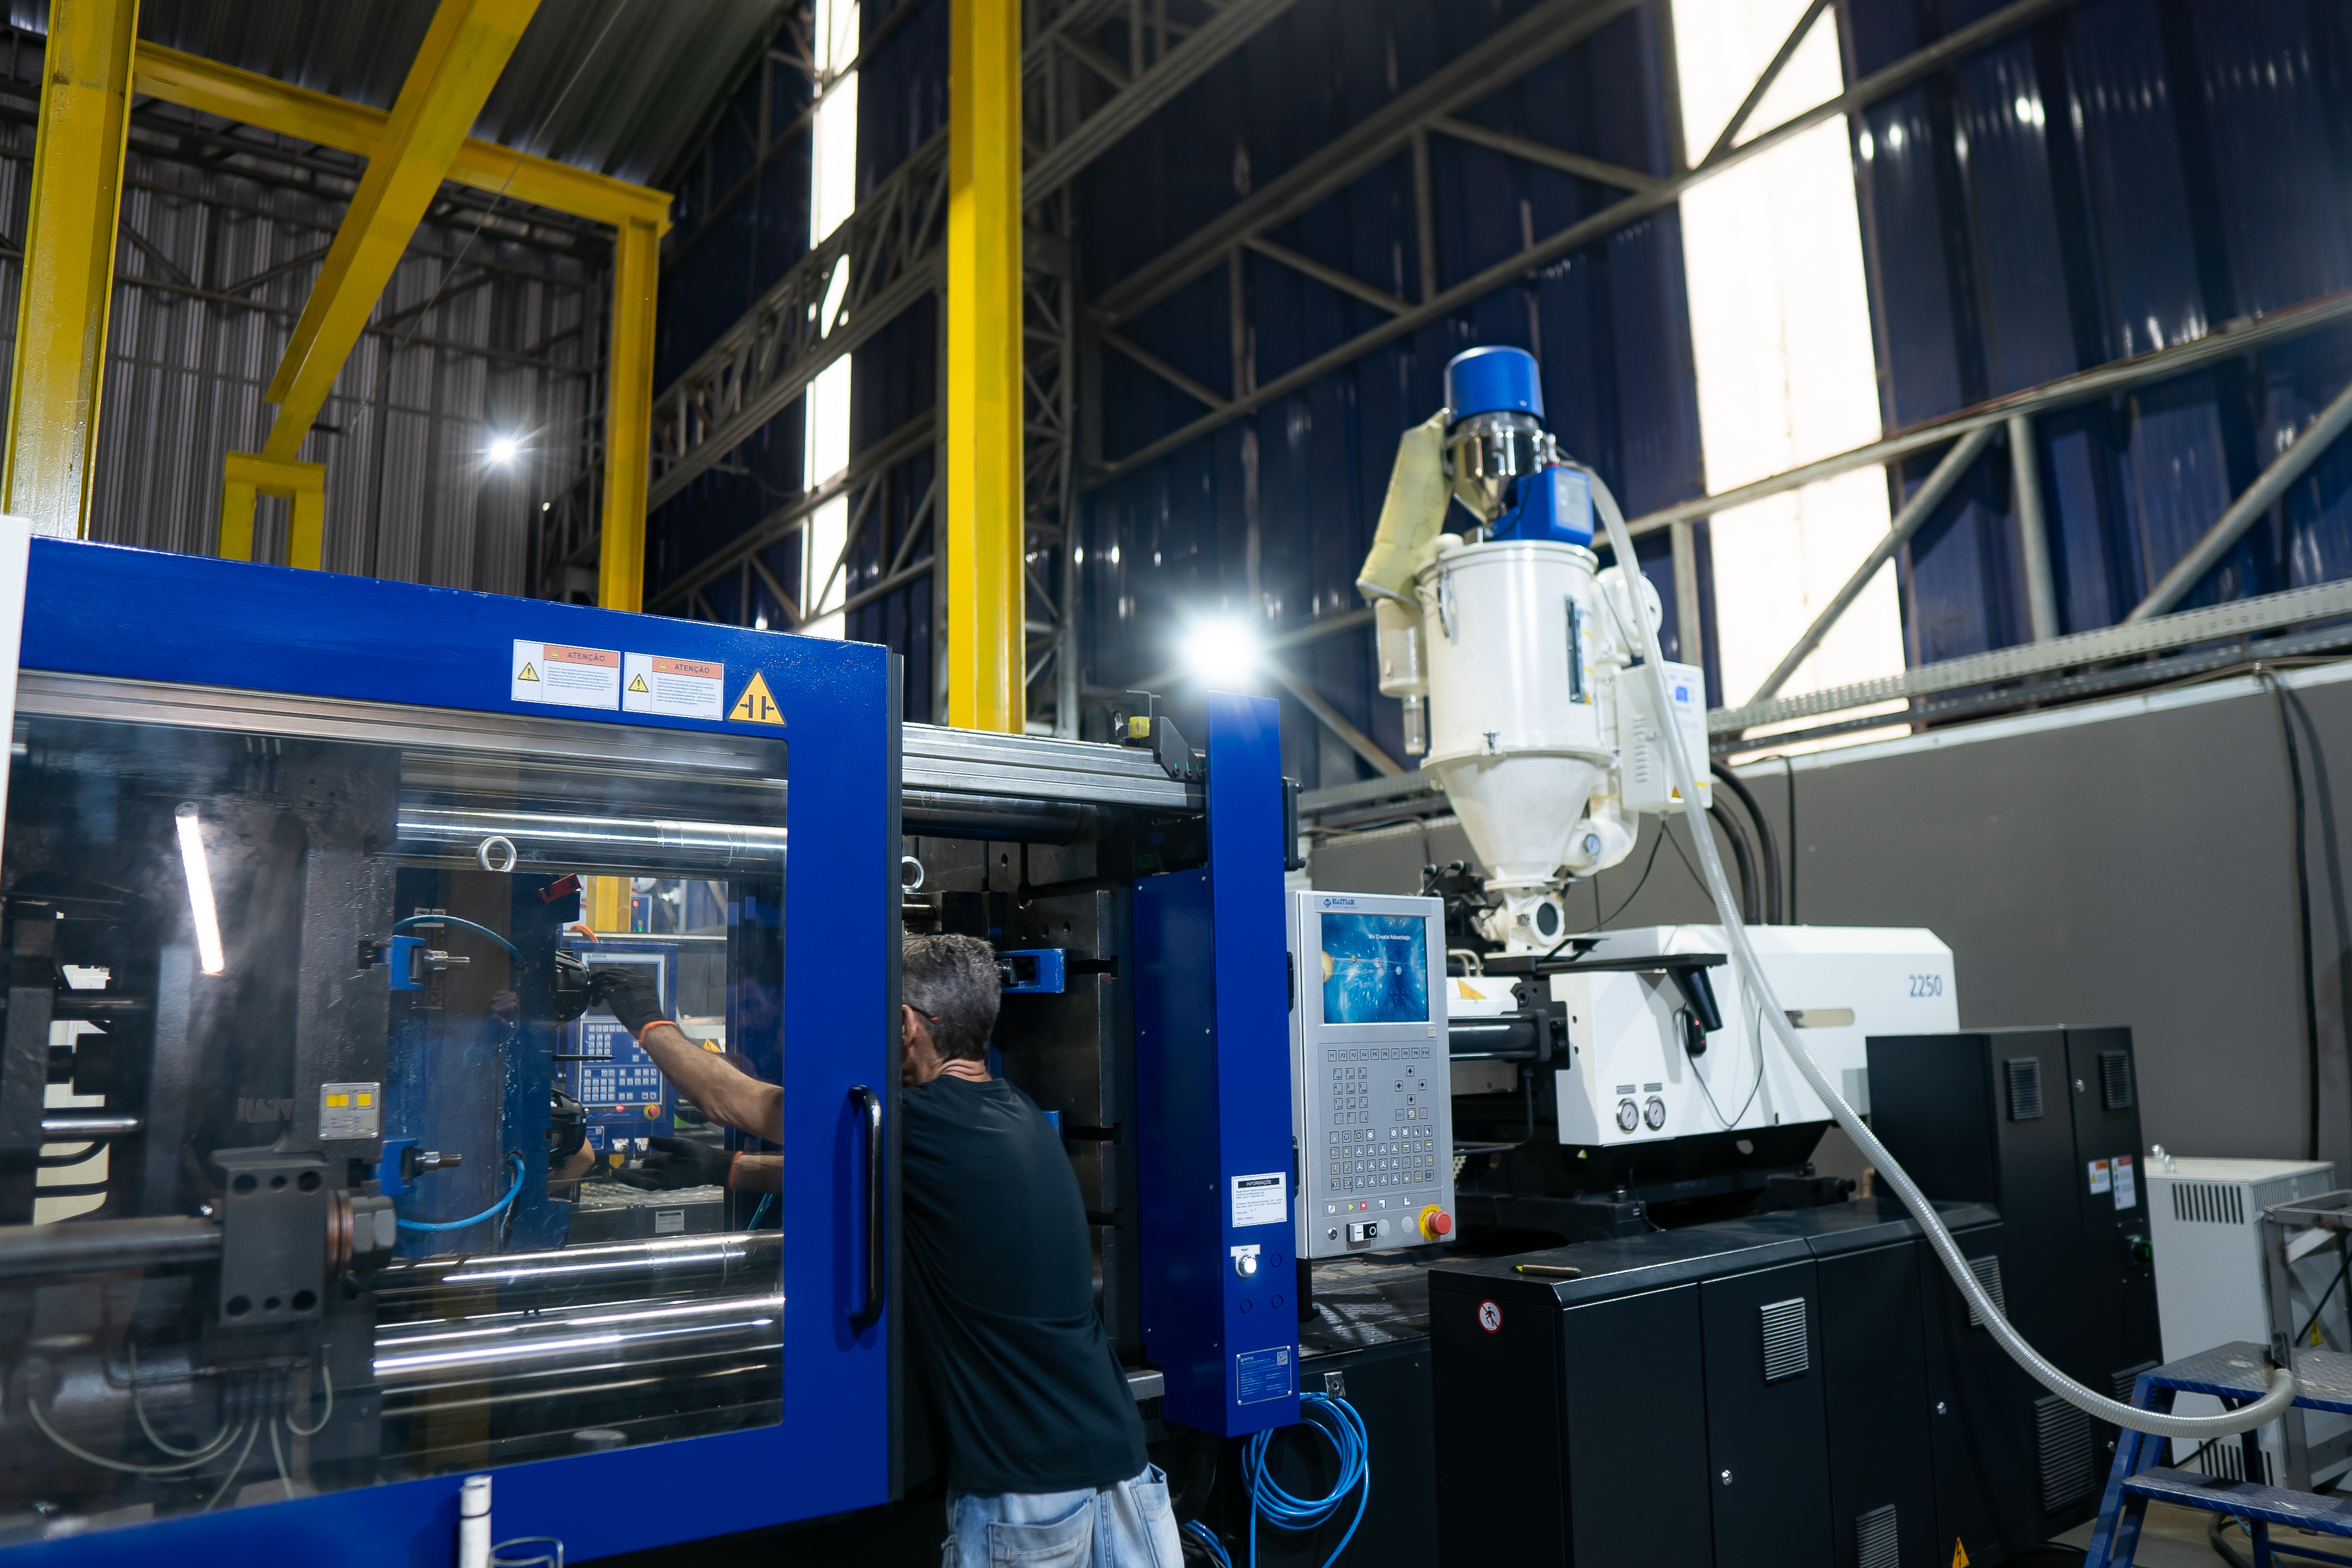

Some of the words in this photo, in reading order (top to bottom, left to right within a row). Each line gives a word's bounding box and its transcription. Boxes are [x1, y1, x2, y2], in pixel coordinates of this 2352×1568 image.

[567, 652, 605, 662] ATENÇÃO
[674, 664, 710, 674] ATENÇÃO
[1909, 973, 1942, 997] 2250
